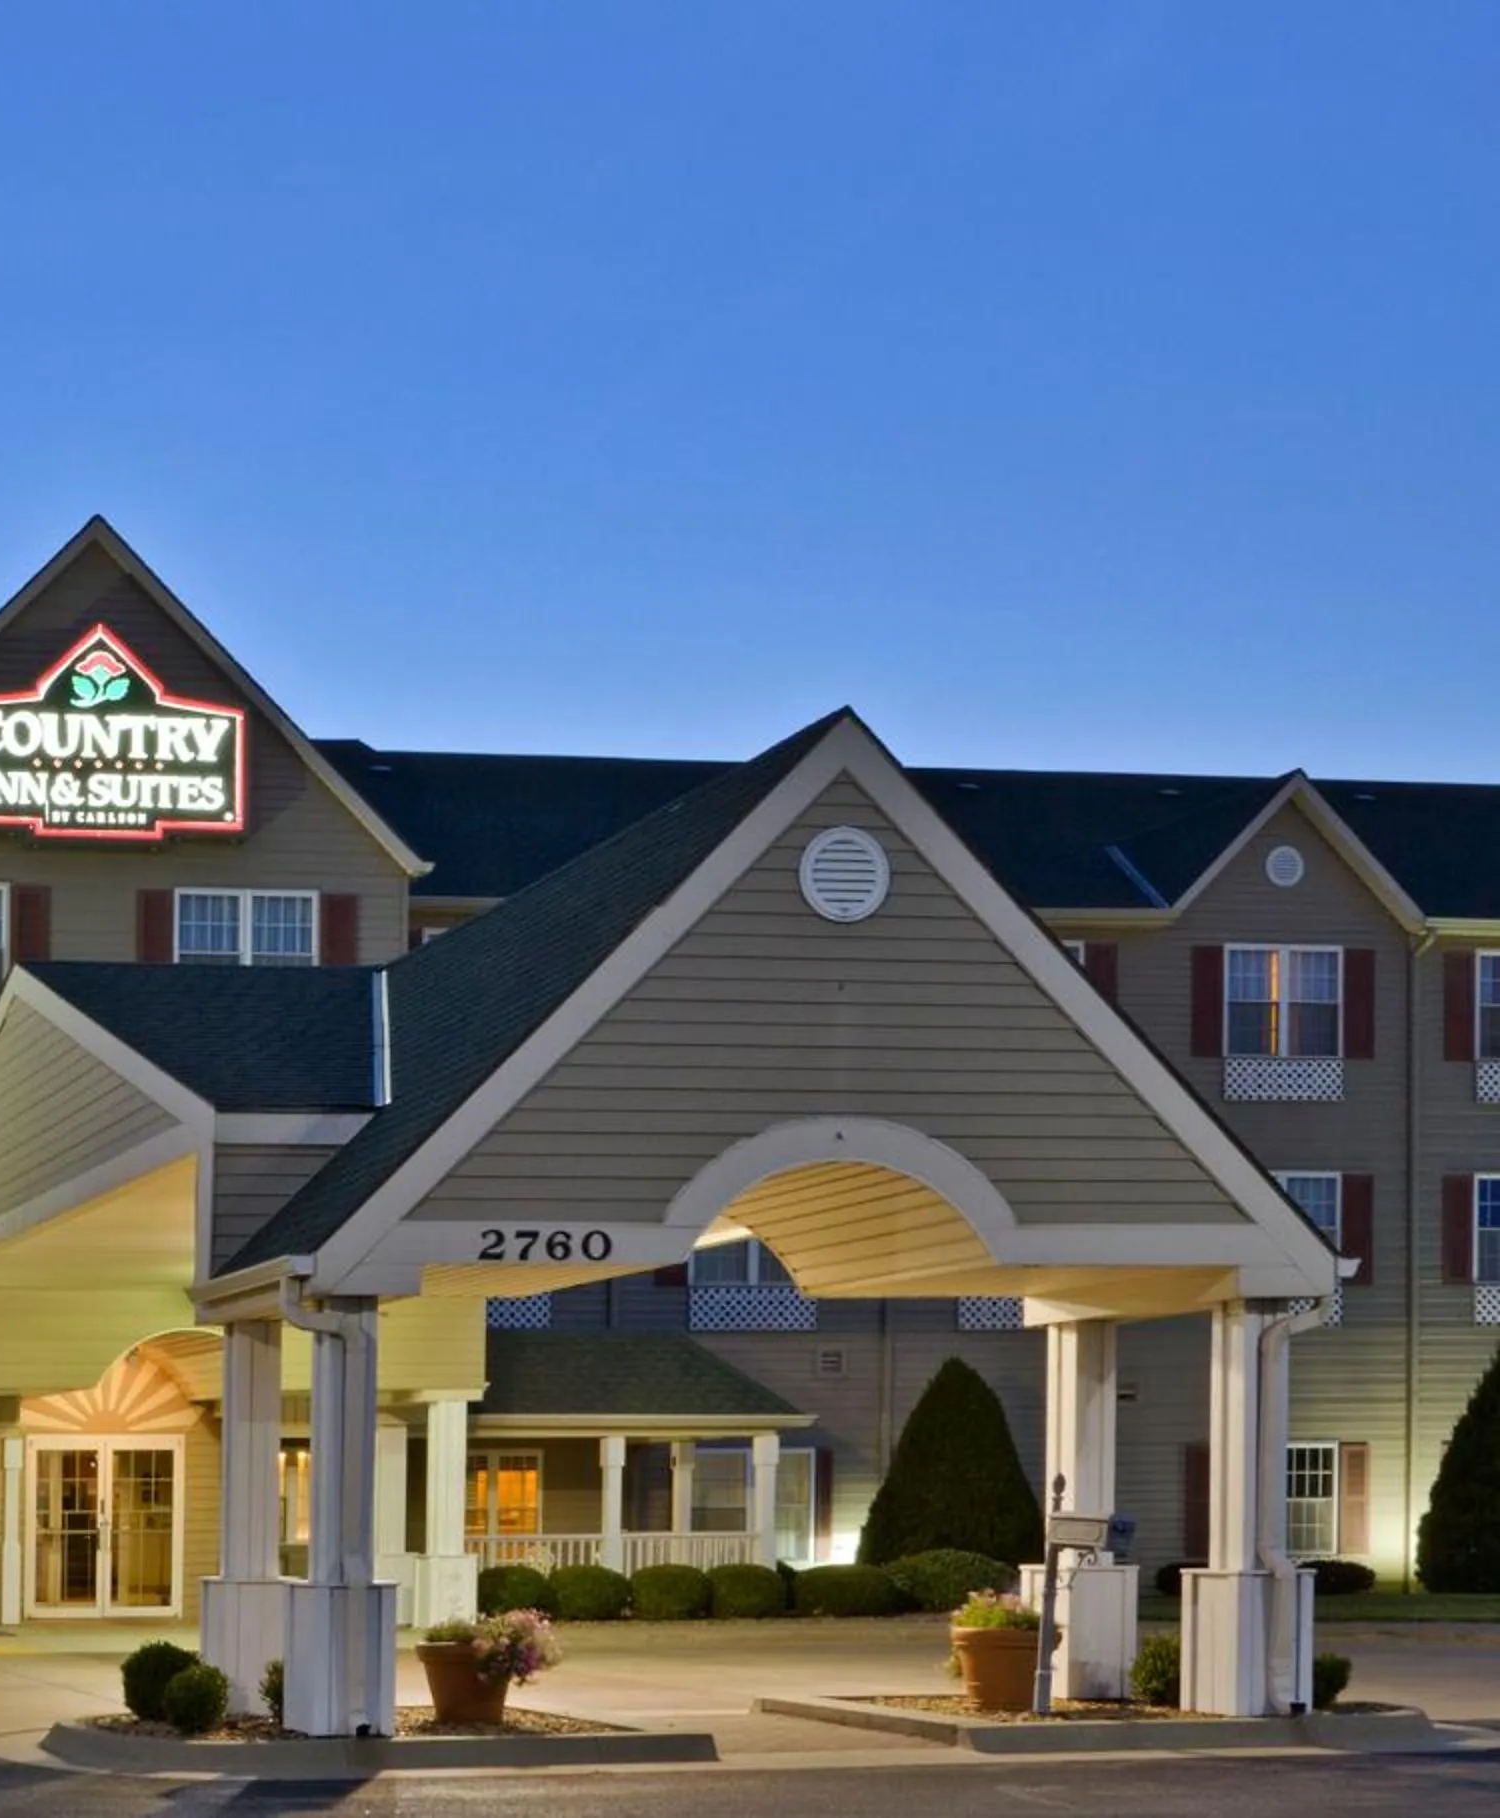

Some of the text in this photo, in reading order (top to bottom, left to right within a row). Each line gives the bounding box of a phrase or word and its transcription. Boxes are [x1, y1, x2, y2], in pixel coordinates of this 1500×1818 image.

[50, 772, 85, 807] &
[88, 774, 225, 811] SUITES
[478, 1229, 612, 1260] 2760
